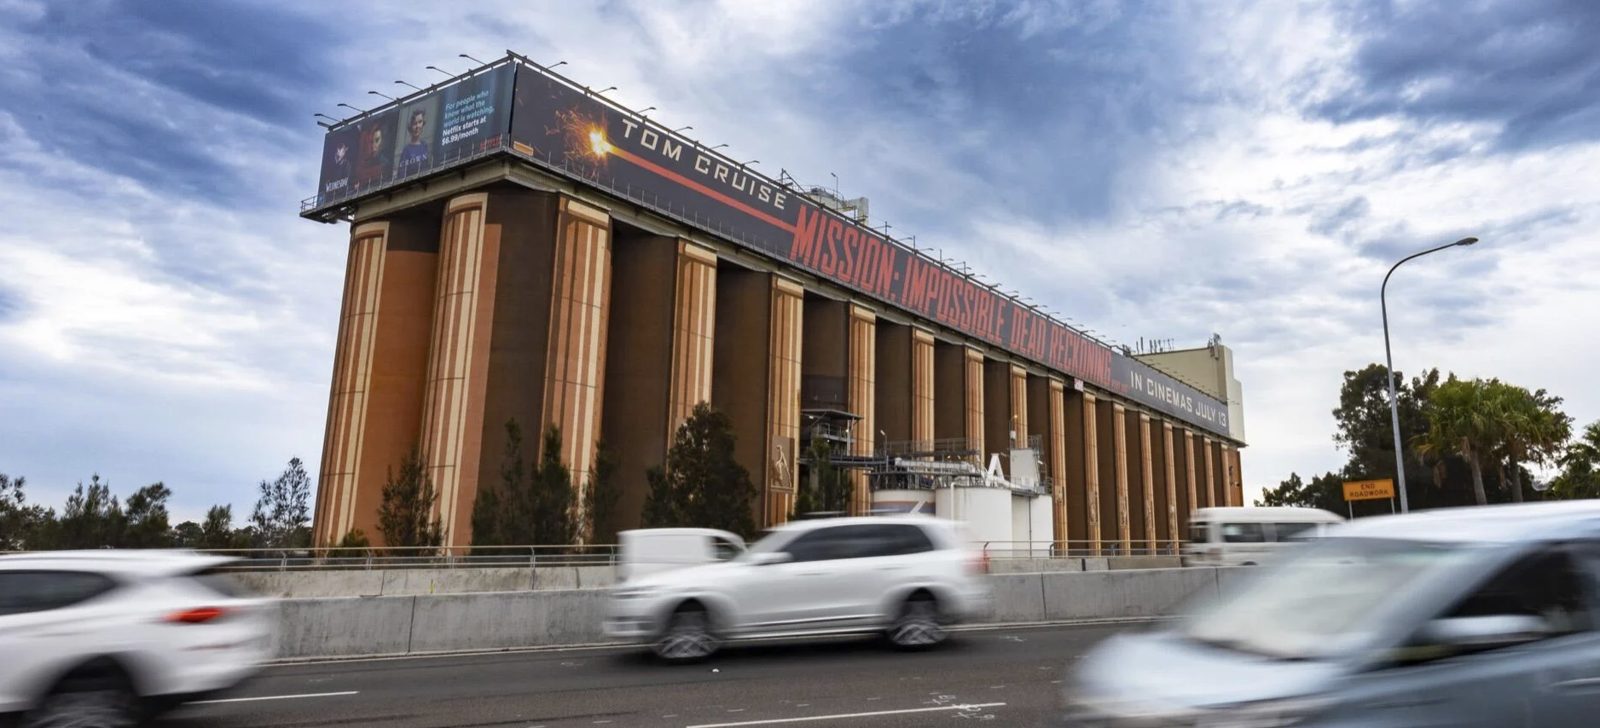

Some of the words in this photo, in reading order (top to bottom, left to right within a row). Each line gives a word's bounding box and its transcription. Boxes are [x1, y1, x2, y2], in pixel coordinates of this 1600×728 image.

[445, 103, 456, 111] For
[456, 95, 475, 109] people
[476, 90, 489, 99] who
[460, 102, 475, 113] what
[475, 100, 486, 108] the
[442, 125, 462, 137] Netflix
[462, 119, 479, 130] starts
[479, 115, 487, 124] at
[443, 116, 460, 128] world
[441, 127, 479, 146] $6.99/month
[622, 118, 682, 162] TOM
[694, 154, 786, 210] CRUISE
[789, 203, 900, 302] MISSION:
[902, 255, 1007, 343] IMPOSSIBLE
[1009, 305, 1048, 360] DEAD
[1048, 323, 1112, 386] RECKONING
[1130, 370, 1143, 391] IN
[1146, 378, 1193, 413] CINEMAS
[1195, 401, 1216, 422] JULY
[1218, 410, 1228, 427] 13
[1350, 489, 1389, 497] ROADWORK
